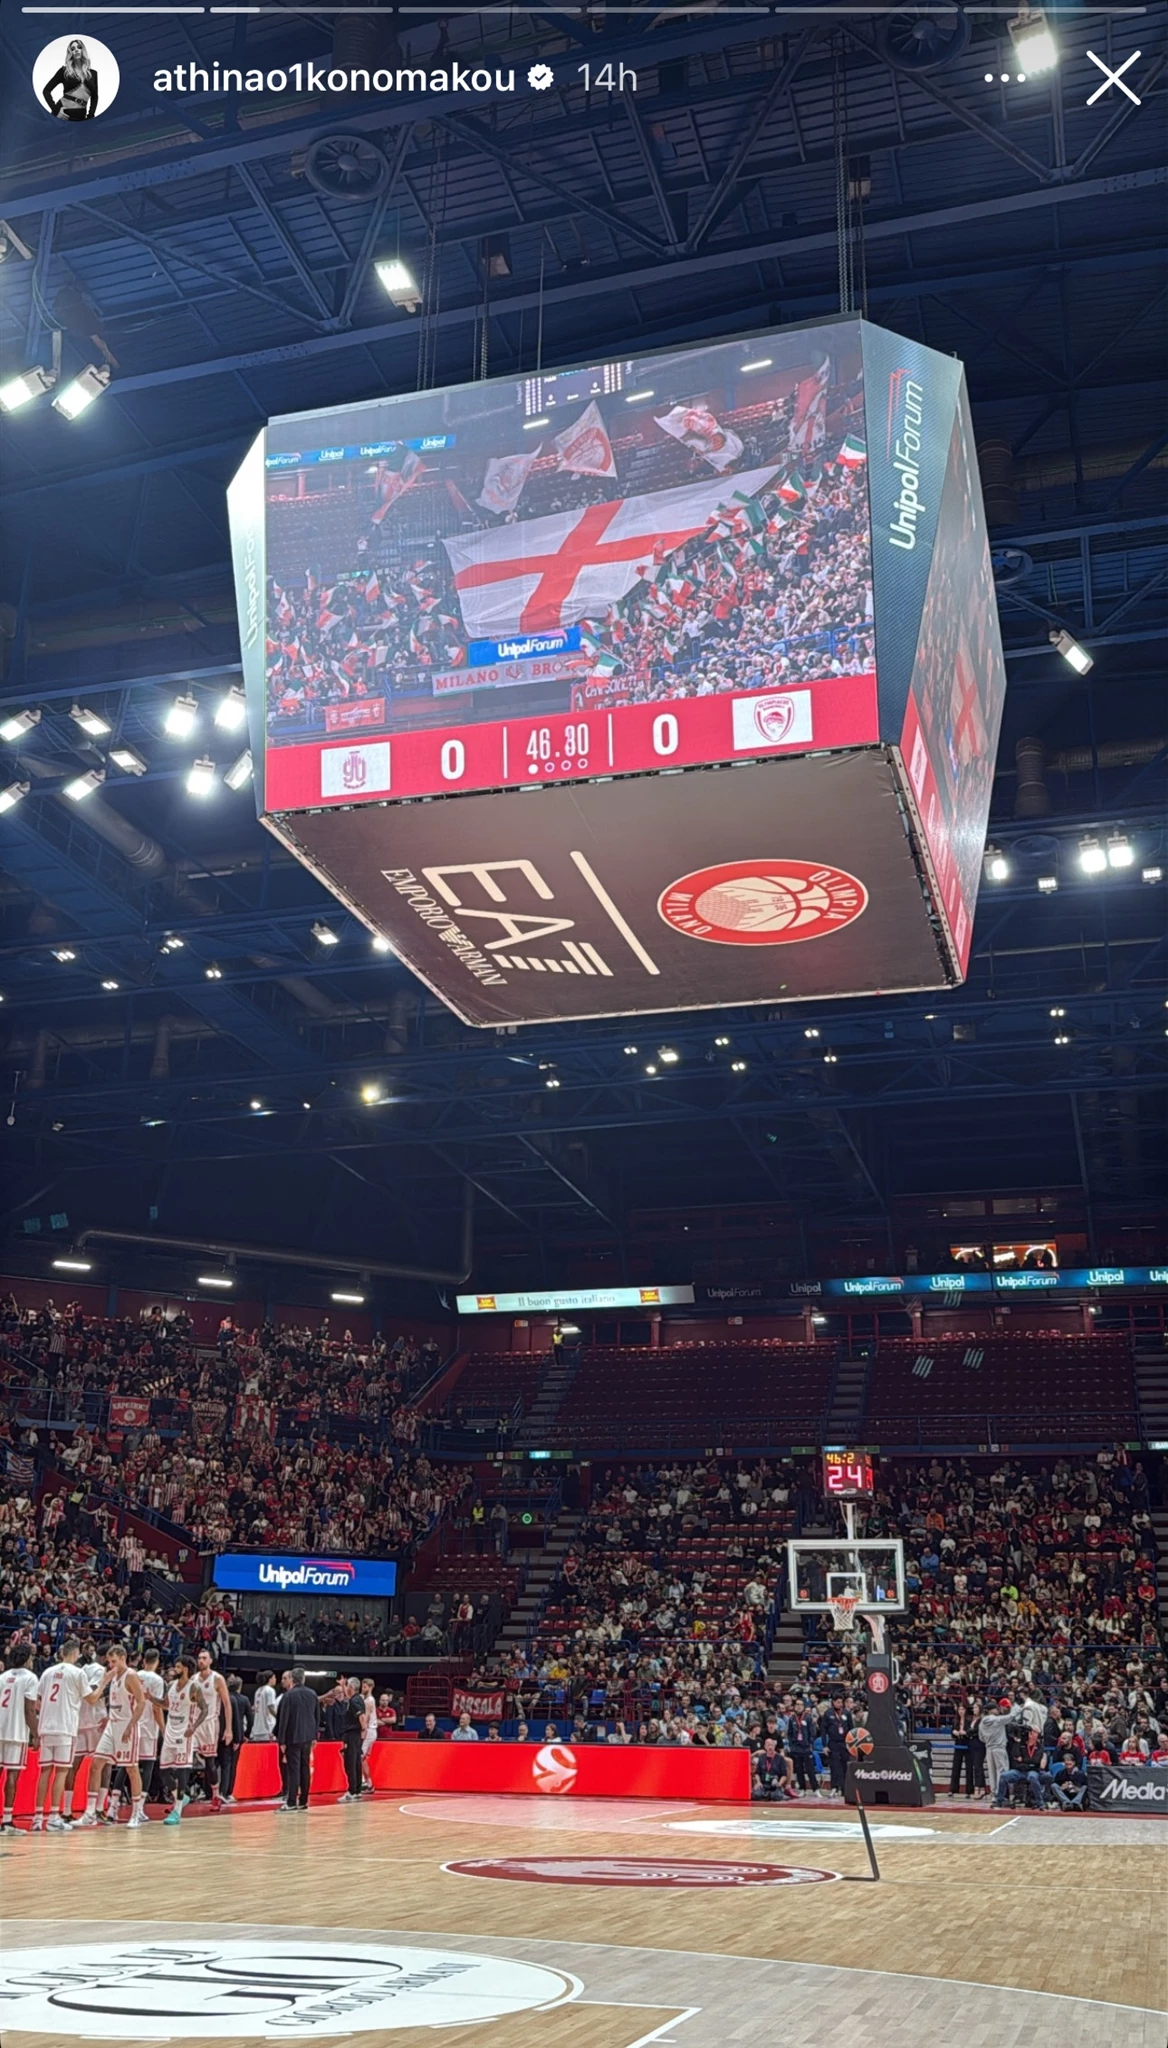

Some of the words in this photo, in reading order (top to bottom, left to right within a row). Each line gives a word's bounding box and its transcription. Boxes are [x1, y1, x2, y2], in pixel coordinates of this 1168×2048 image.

[888, 380, 925, 550] UnipolForum
[497, 638, 564, 659] UnipolForum
[435, 669, 500, 690] MILANO
[440, 739, 466, 780] 0
[652, 713, 680, 756] 0
[808, 869, 858, 920] OLIMPIA
[665, 891, 713, 935] MILANO
[380, 867, 455, 929] EMPORIO
[446, 943, 509, 986] ARMANI
[931, 1275, 965, 1289] Unipol
[996, 1275, 1057, 1289] UnipolForum
[1088, 1269, 1125, 1285] Unipol
[707, 1287, 762, 1300] UnipolForum
[790, 1281, 822, 1295] Unipol
[844, 1281, 902, 1295] UnipolForum
[528, 1296, 551, 1306] buon
[553, 1297, 579, 1308] gusto
[826, 1452, 855, 1464] 46:2
[828, 1465, 863, 1489] 24
[258, 1563, 350, 1589] UnipolForum
[1, 1688, 12, 1708] 2
[49, 1683, 60, 1702] 2
[452, 1693, 503, 1715] FARSALA
[1099, 1778, 1166, 1801] Media
[264, 1990, 397, 2027] GIORGIO
[374, 1961, 482, 1992] ARMANI
